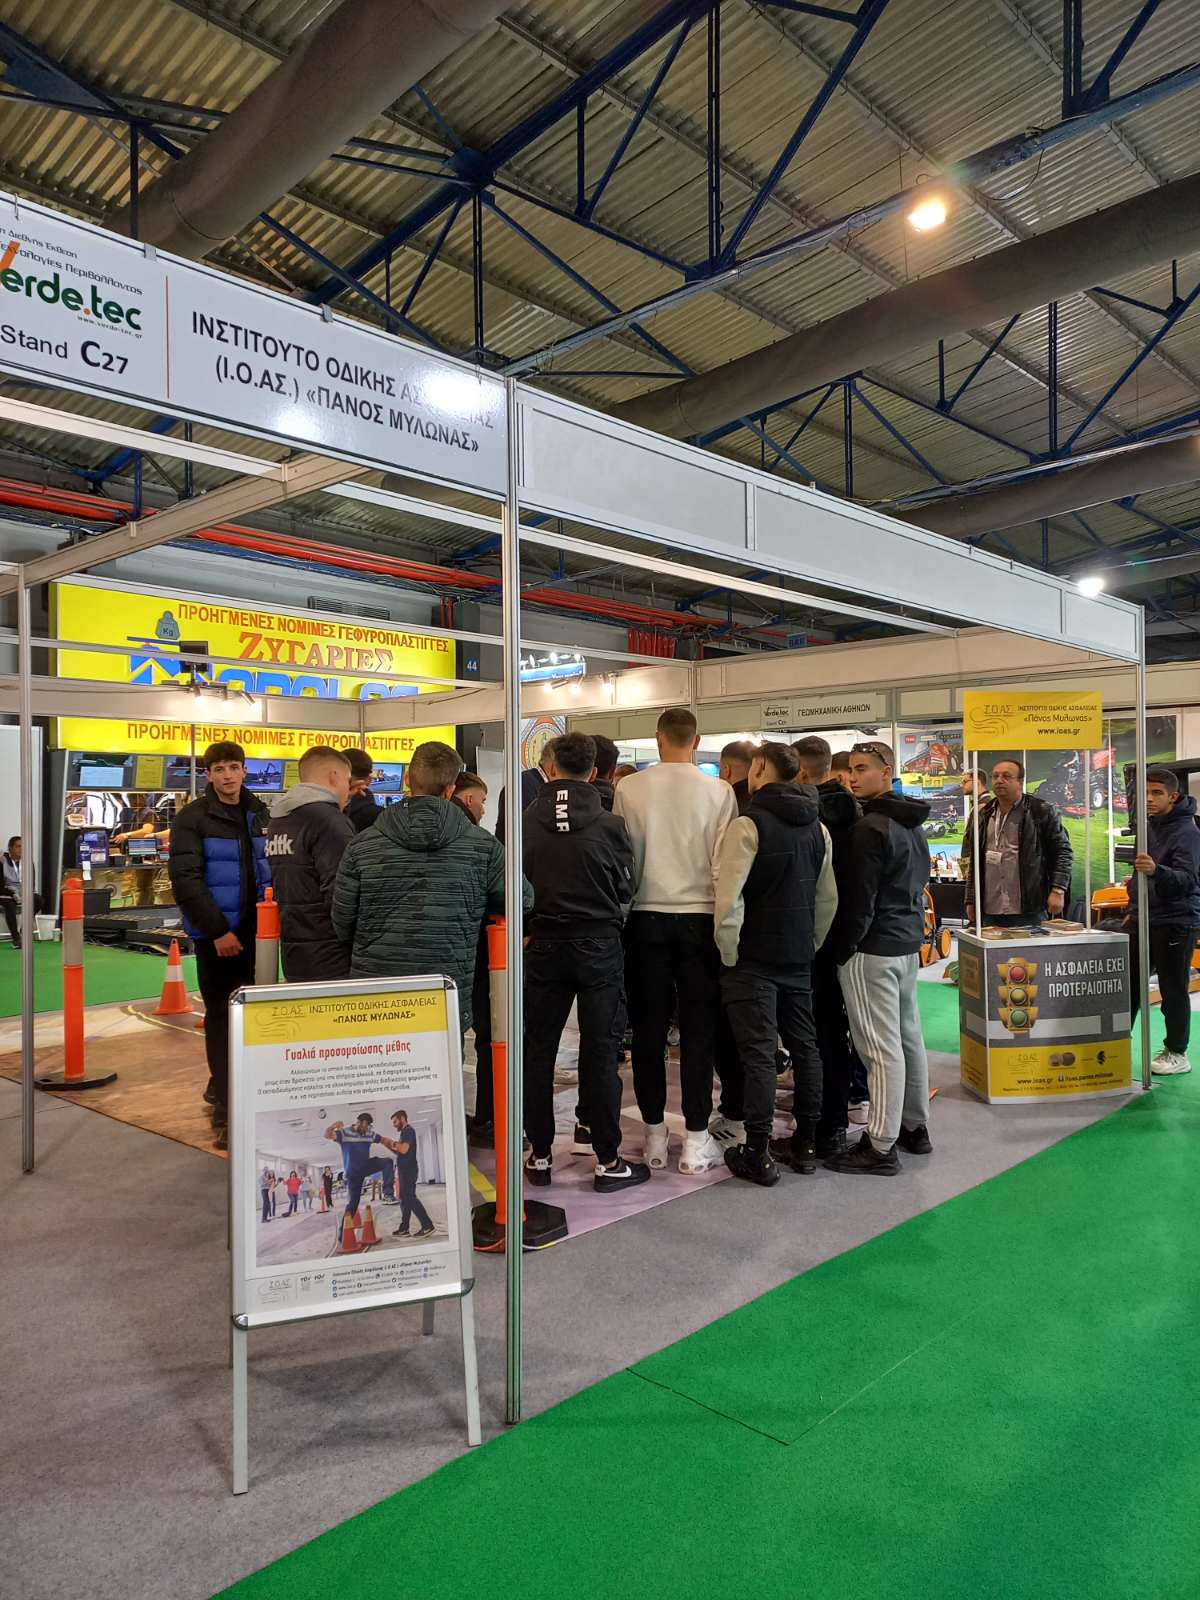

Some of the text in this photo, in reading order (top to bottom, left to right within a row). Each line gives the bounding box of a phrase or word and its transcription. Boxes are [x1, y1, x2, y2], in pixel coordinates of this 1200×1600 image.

[0, 324, 129, 375] Stand C27
[192, 310, 320, 372] ΙΝΣΤΙΤΟΥΤΟ
[325, 356, 396, 398] ΟΔΙΚΗΣ
[215, 354, 479, 453] (Ι.Ο.ΑΣ.) «ΠΑΝΟΣ ΜΥΛΩΝΑΣ»
[178, 603, 450, 653] ΠΡΟΗΓΜΕΝΕΣ ΝΟΜΙΜΕΣ ΓΕΦΥΡΟΠΛΑΣΤΙΓΓΕΣ
[238, 631, 395, 673] ΖΥΓΑΡΙΕΣ
[466, 660, 478, 672] 44
[843, 703, 871, 714] ΑΘΗΝΩΝ
[127, 723, 230, 743] ΠΡΟΗΓΜΕΝΕΣ
[233, 729, 295, 747] ΝΟΜΙΜΕΣ
[1037, 727, 1081, 736] www.ioas.gr
[1044, 957, 1125, 977] Η ΑΣΦΑΛΕΙΑ ΕΧΕΙ
[1048, 978, 1123, 998] ΠΡΟΤΕΡΑΙΟΤΗΤΑ
[308, 1002, 357, 1015] ΙΝΣΤΙΤΟΥΤΟ
[358, 999, 389, 1012] ΟΔΙΚΗΣ
[390, 996, 437, 1009] ΑΣΦΑΛΕΙΑΣ
[332, 1010, 416, 1024] «ΠΑΝΟΣ ΜΥΛΩΝΑΣ»
[284, 1040, 411, 1061] Γυαλιά προσομοίωσης μέθης
